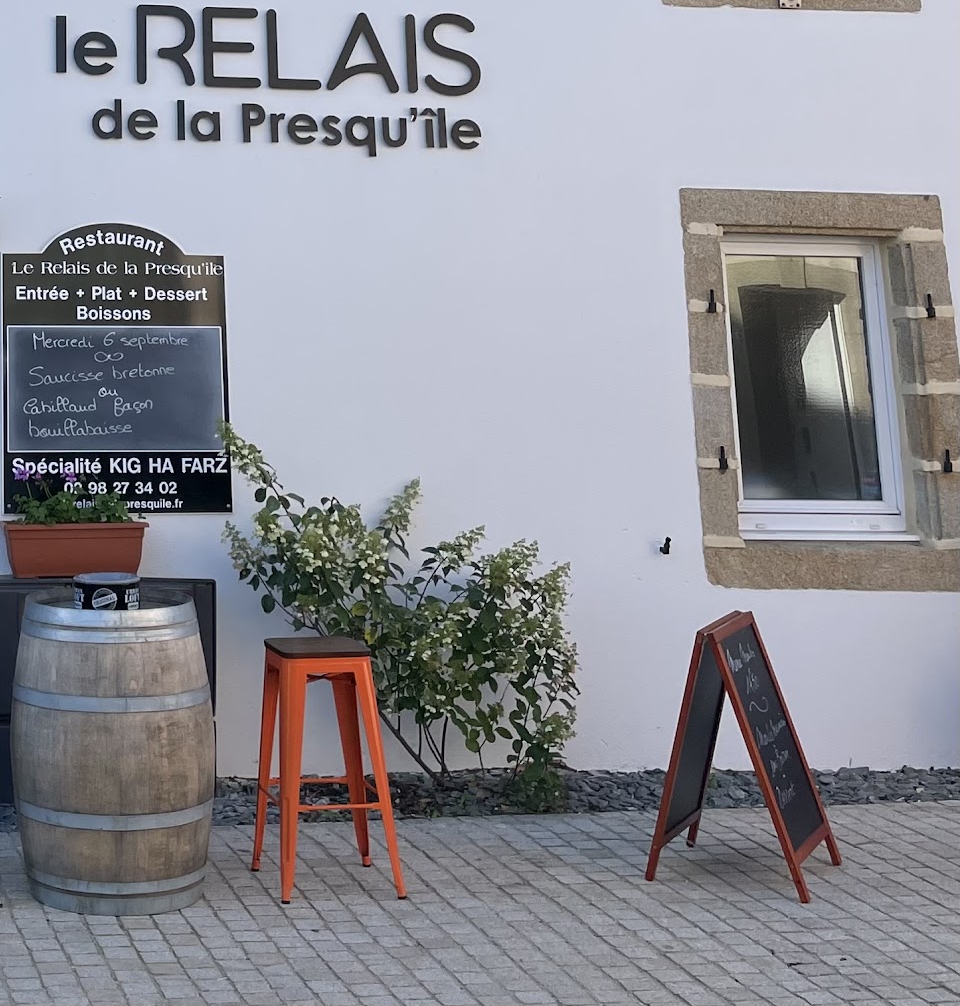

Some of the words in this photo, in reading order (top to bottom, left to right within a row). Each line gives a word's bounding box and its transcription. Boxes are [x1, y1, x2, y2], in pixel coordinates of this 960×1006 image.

[55, 15, 118, 75] le
[136, 4, 482, 95] RELAIS
[92, 99, 158, 140] de
[177, 99, 221, 142] la
[242, 102, 482, 157] Presqu'île
[59, 230, 165, 256] Restaurant
[11, 261, 34, 275] Le
[41, 261, 90, 275] Relais
[96, 261, 118, 275] de
[124, 261, 138, 275] la
[16, 285, 69, 300] Entrée
[91, 285, 122, 300] Plat
[144, 286, 208, 301] Dessert
[76, 305, 151, 320] Boissons
[33, 331, 94, 350] Mercredi
[103, 332, 116, 346] 6
[120, 333, 189, 350] septembre
[29, 366, 104, 386] Saucisse
[112, 363, 175, 380] bretonne
[98, 387, 118, 397] ou
[23, 396, 97, 415] Cabillaud
[114, 397, 153, 417] façon
[28, 418, 133, 437] bouillabaisse
[12, 457, 101, 475] Spécialité
[109, 458, 141, 474] KIG
[149, 458, 174, 474] HA
[182, 457, 228, 474] FARZ
[88, 481, 107, 495] 98
[113, 481, 131, 495] 27
[135, 481, 153, 495] 34
[159, 481, 177, 495] 02
